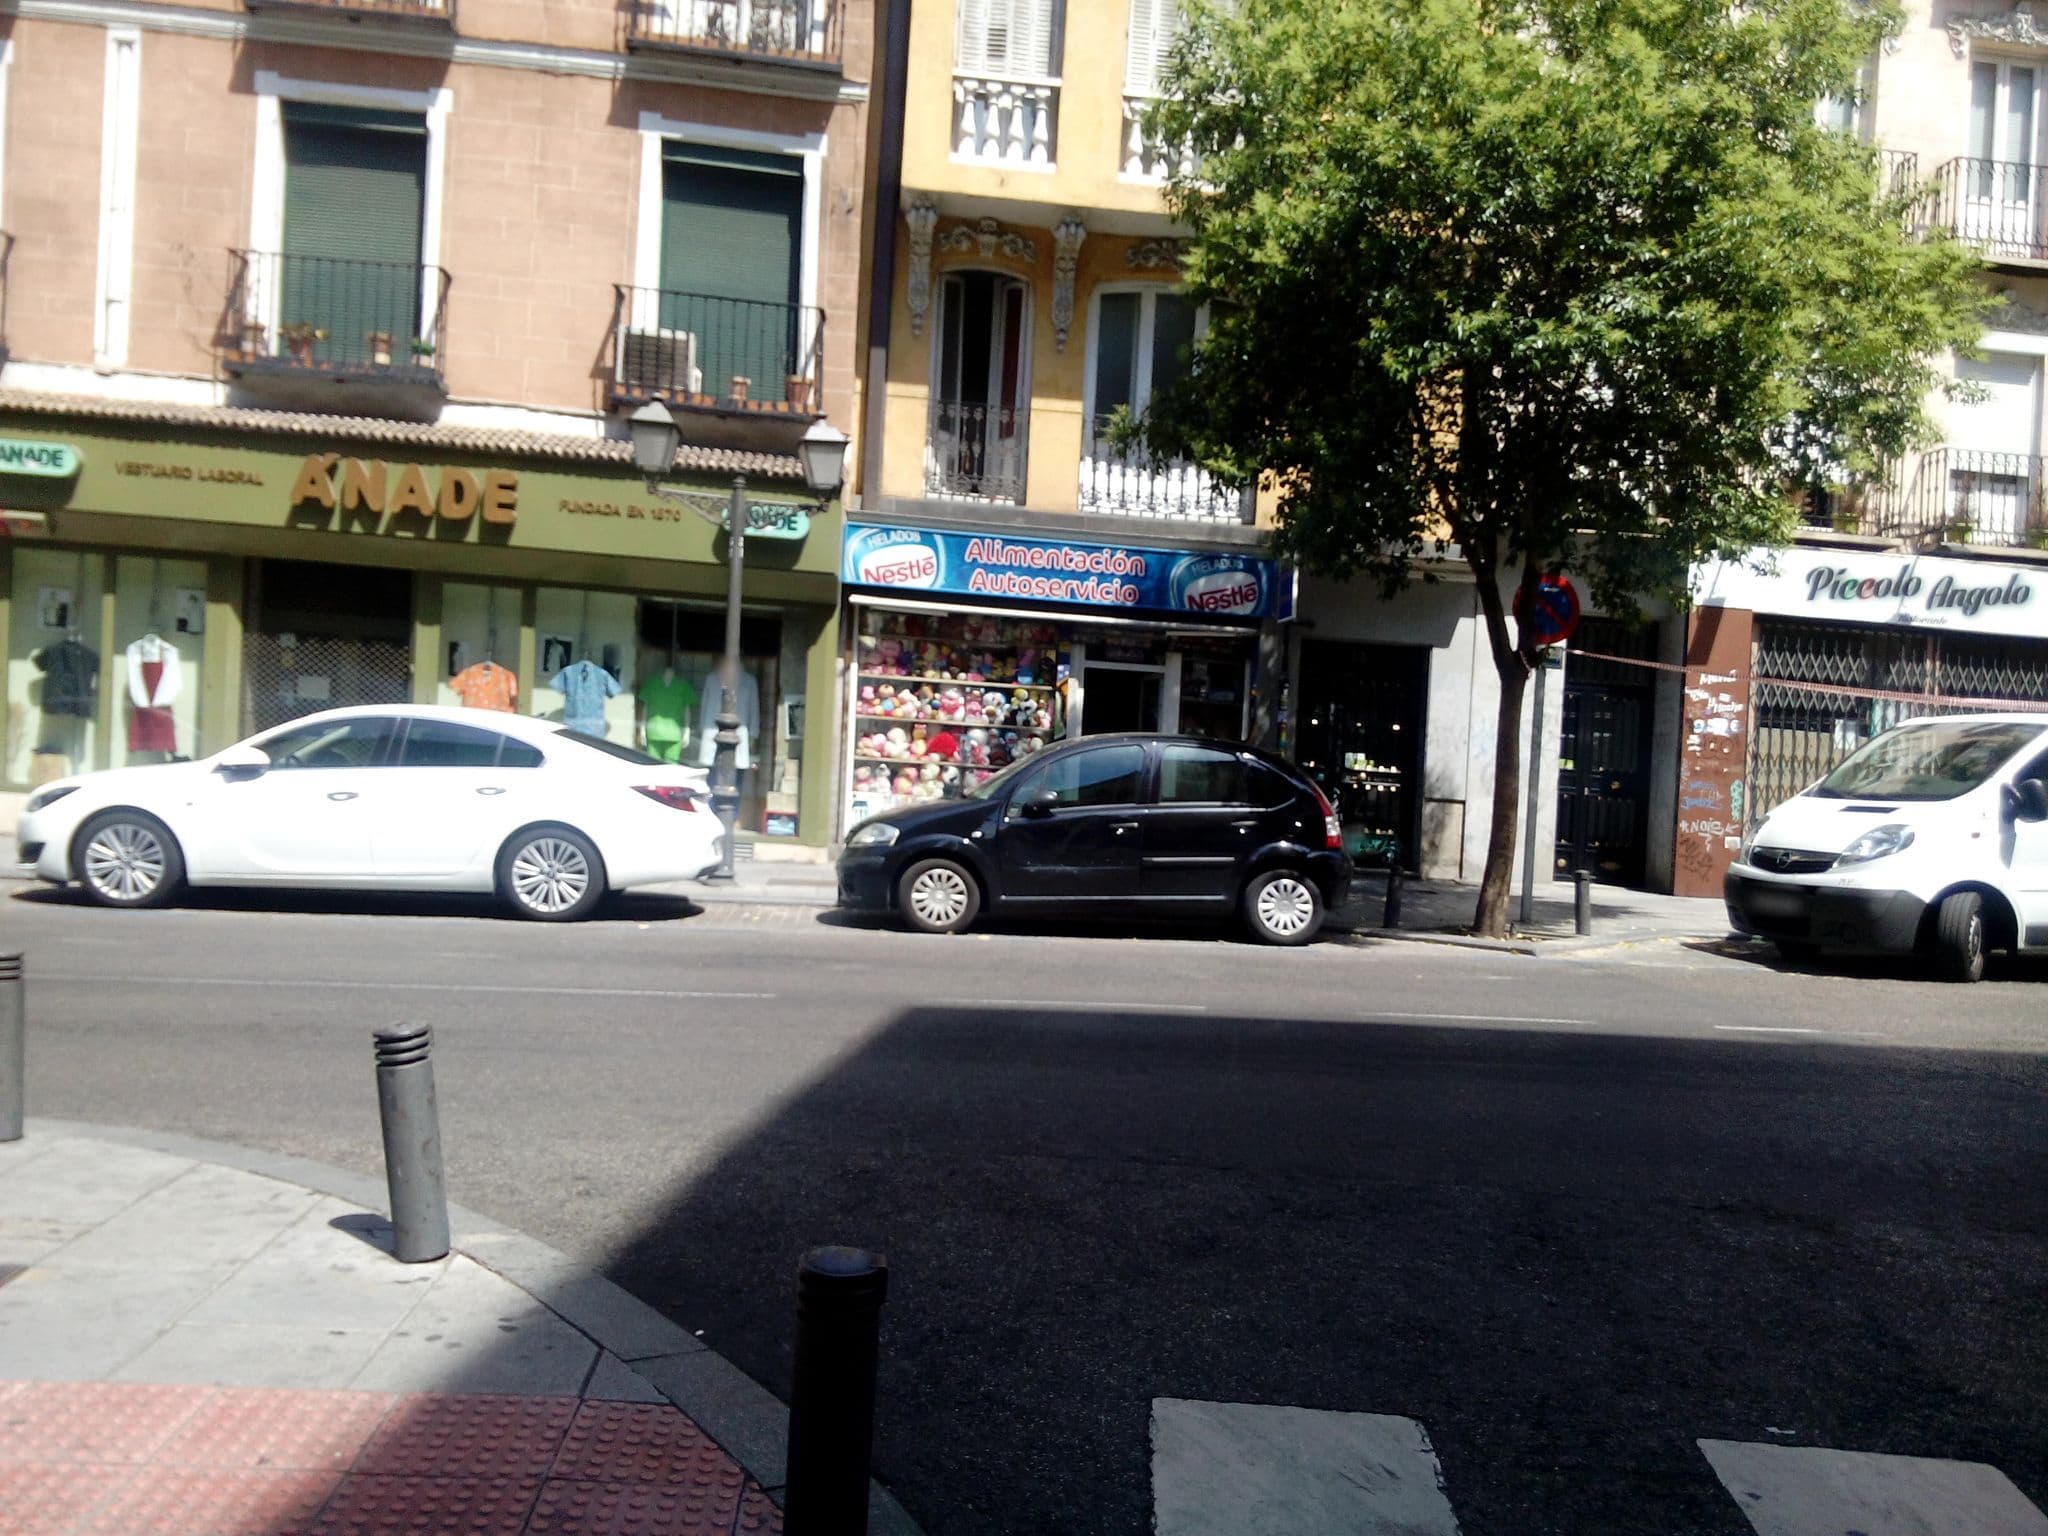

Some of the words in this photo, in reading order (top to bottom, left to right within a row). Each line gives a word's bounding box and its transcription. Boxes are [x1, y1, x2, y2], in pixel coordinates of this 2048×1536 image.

[114, 460, 193, 481] VESTUARIO
[196, 466, 265, 487] LABORAL
[558, 499, 622, 518] FUNDADA
[627, 504, 645, 519] EN
[651, 507, 682, 523] 1870
[866, 529, 921, 549] HELADOS
[964, 538, 1147, 577] Alimentación
[1191, 558, 1244, 577] HELADOS
[968, 568, 1141, 604] Autoservicio
[1806, 563, 1922, 602] Piccolo
[1925, 573, 2031, 617] Angolo
